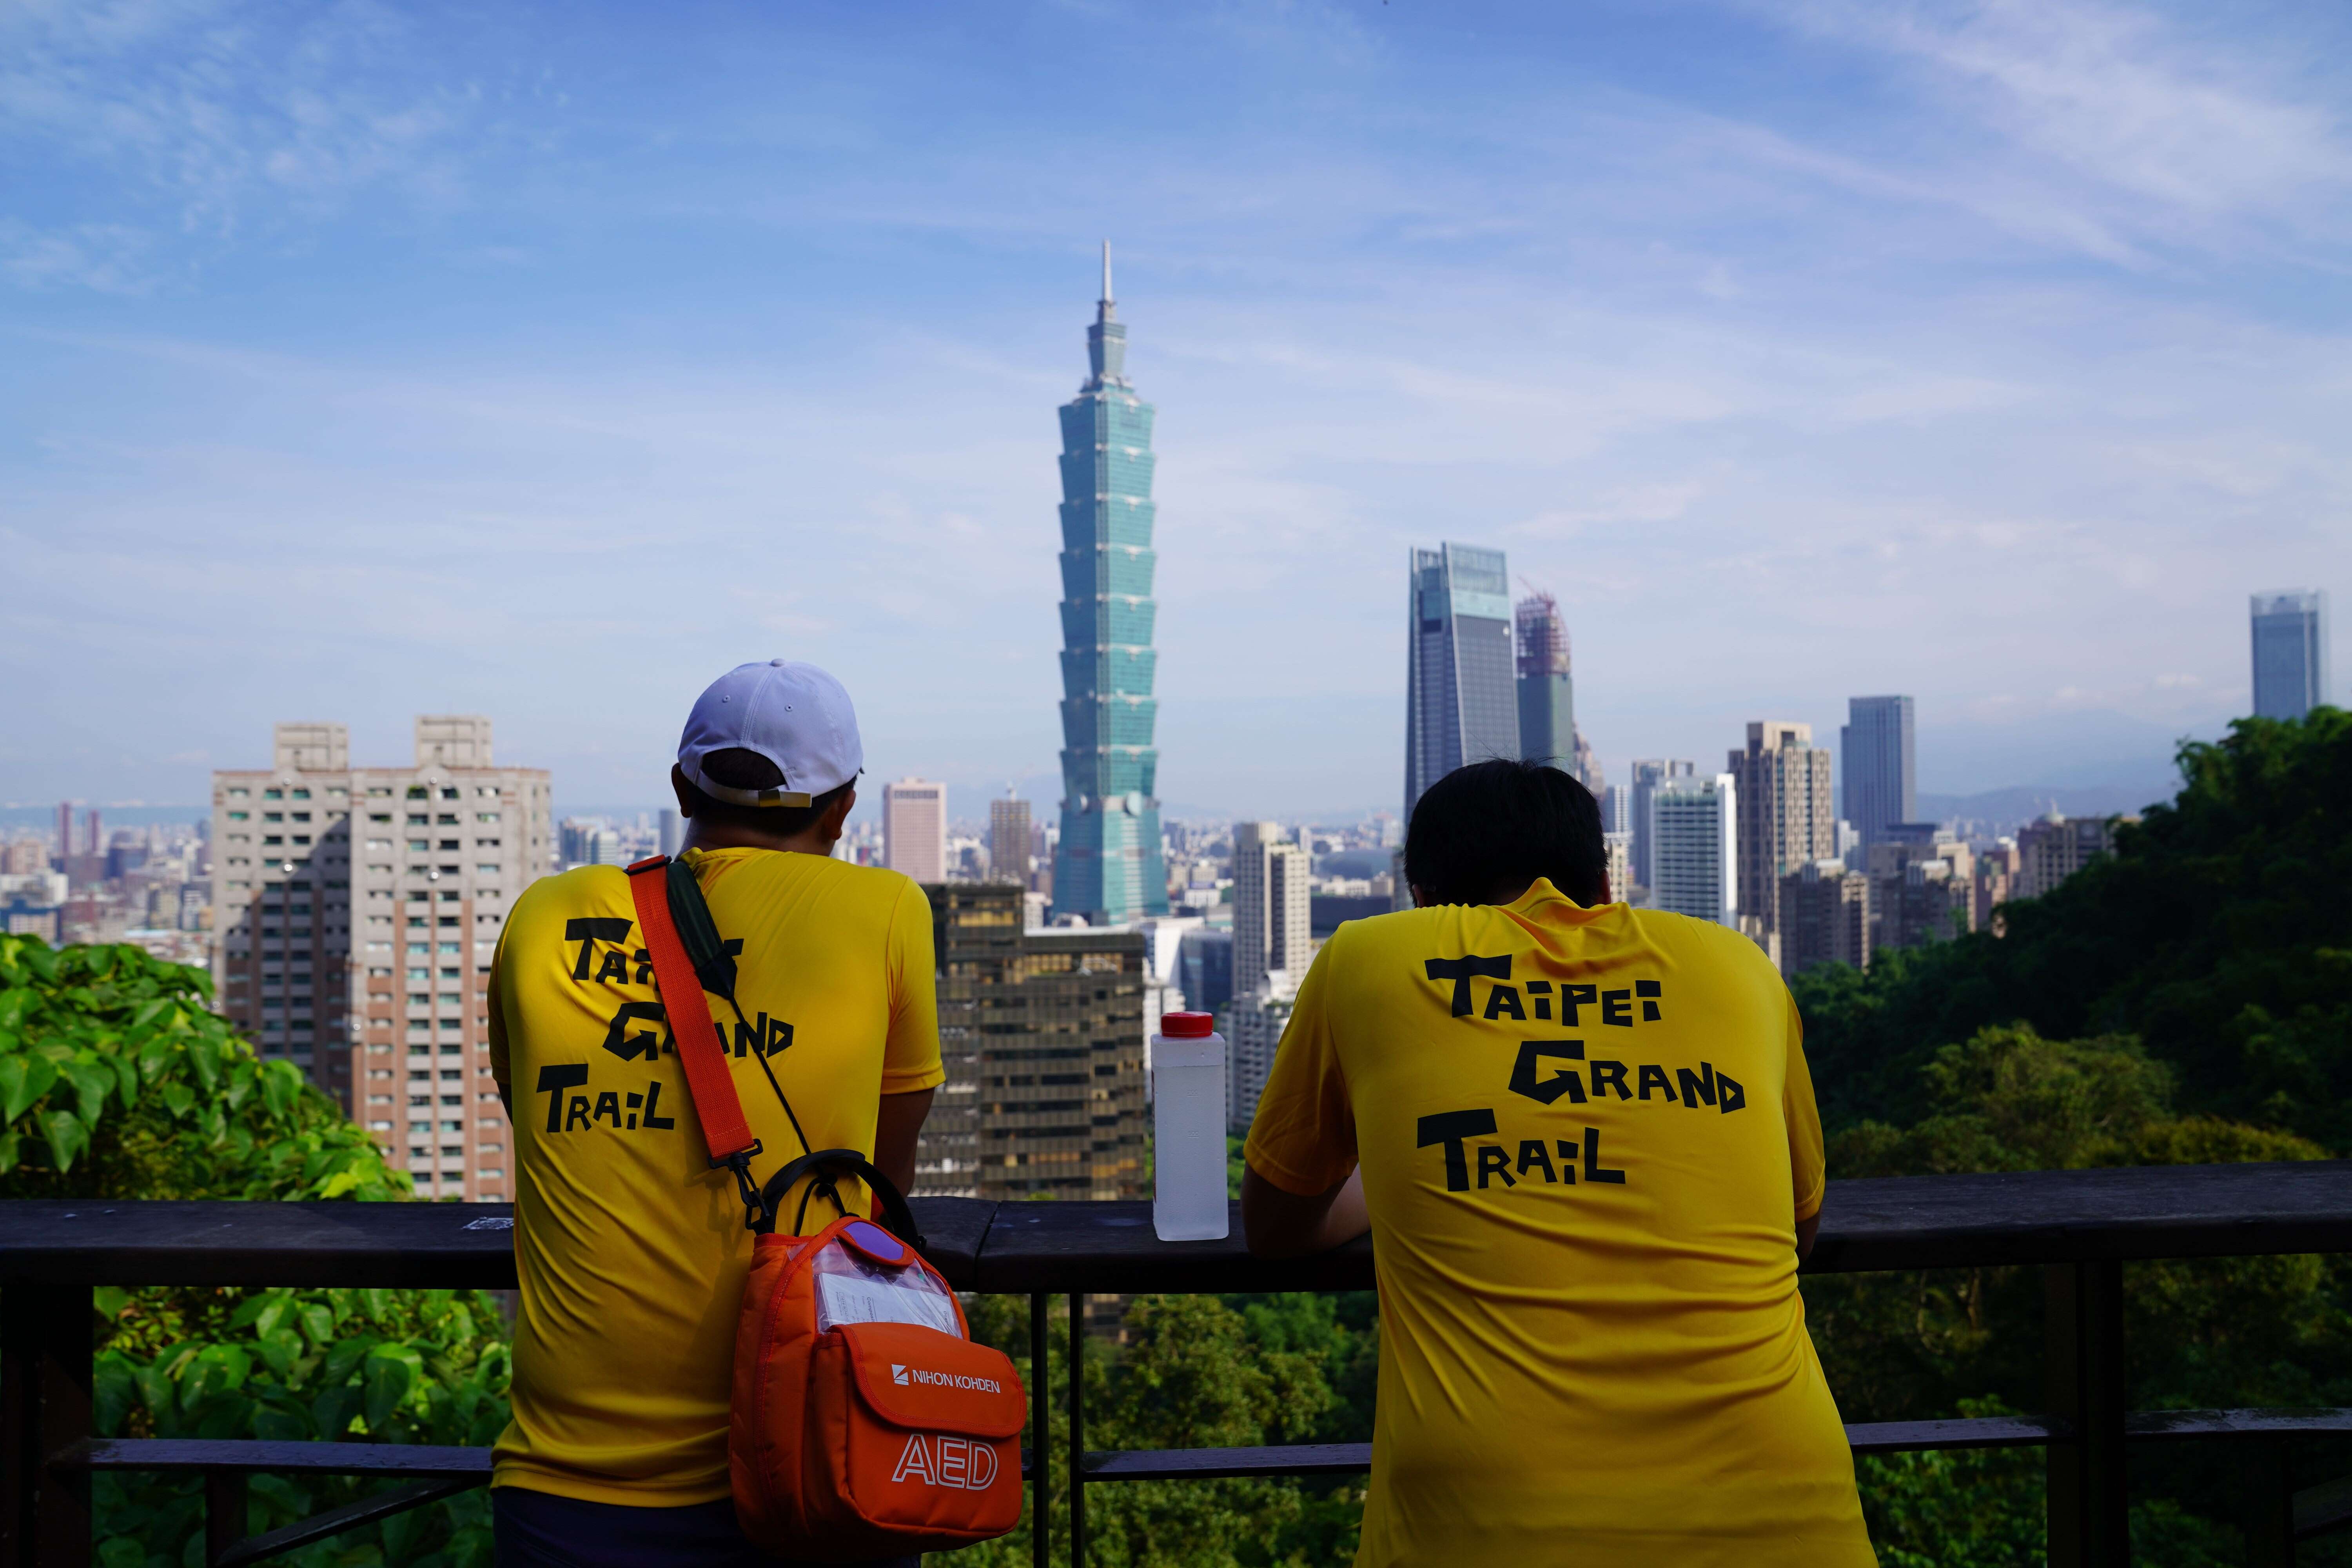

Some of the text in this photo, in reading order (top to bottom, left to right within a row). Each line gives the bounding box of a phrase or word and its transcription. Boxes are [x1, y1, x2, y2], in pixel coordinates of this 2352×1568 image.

[602, 1001, 794, 1061] GND
[1508, 1040, 1746, 1114] GRAND
[912, 1370, 1000, 1393] NIHON KOHDEN
[891, 1433, 998, 1490] AED
